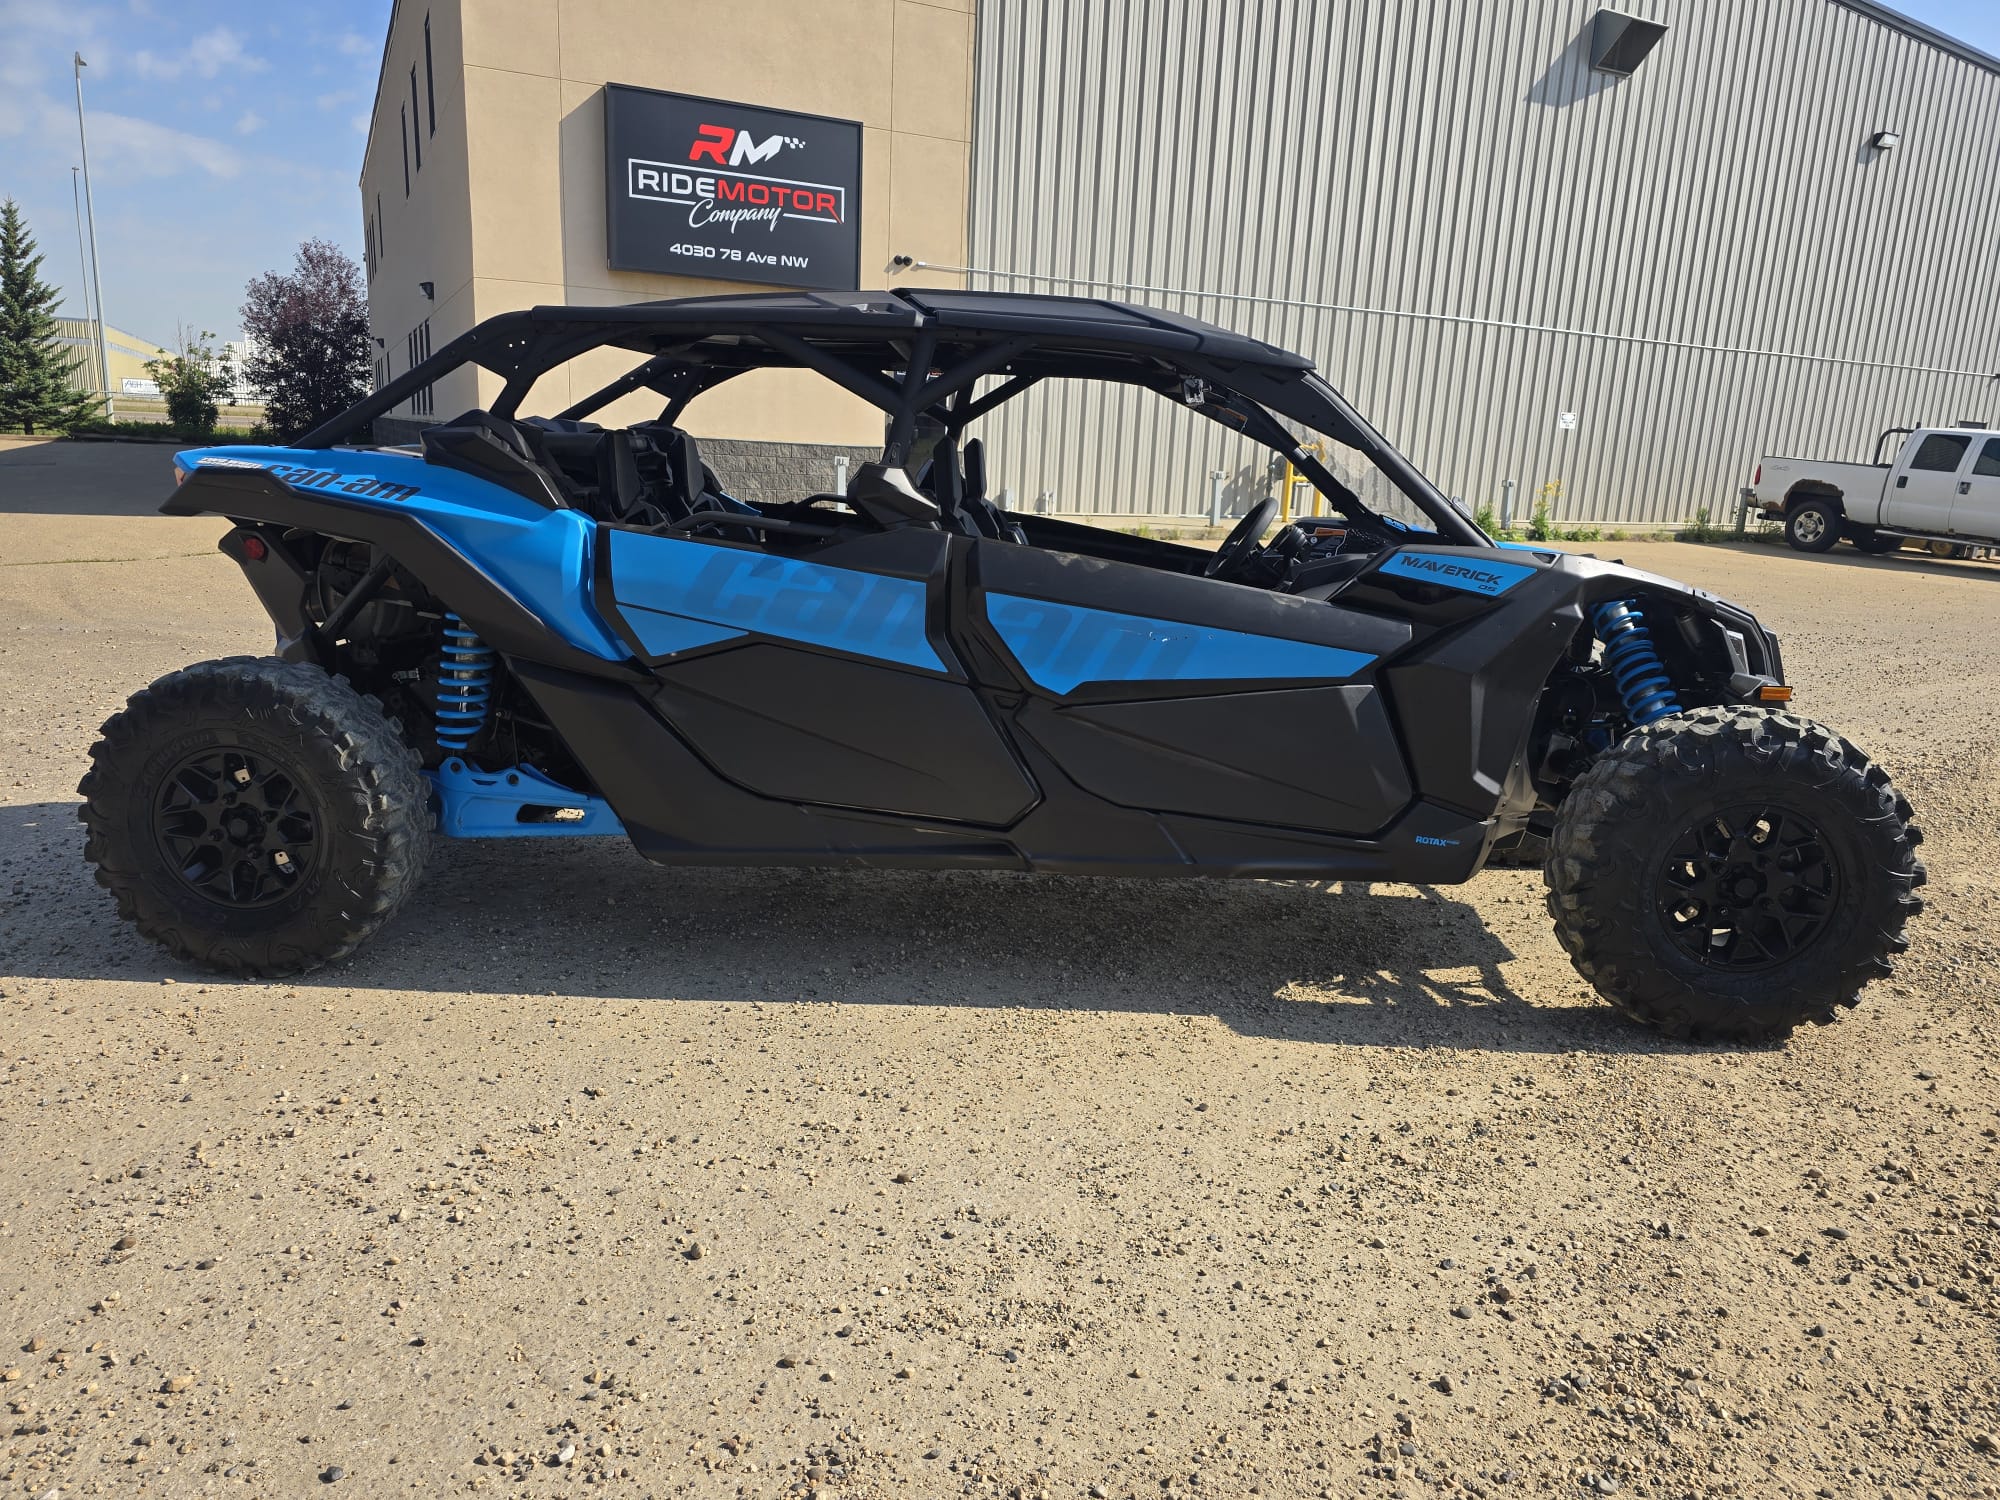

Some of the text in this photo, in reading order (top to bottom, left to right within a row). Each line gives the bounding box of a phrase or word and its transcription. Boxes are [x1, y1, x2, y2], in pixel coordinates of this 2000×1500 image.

[689, 124, 783, 166] RM
[688, 198, 782, 233] Company
[669, 243, 809, 268] 4030 78 Ave NW
[265, 464, 421, 502] can-am
[1401, 555, 1504, 585] MAVERICK
[1415, 835, 1447, 847] ROTAX
